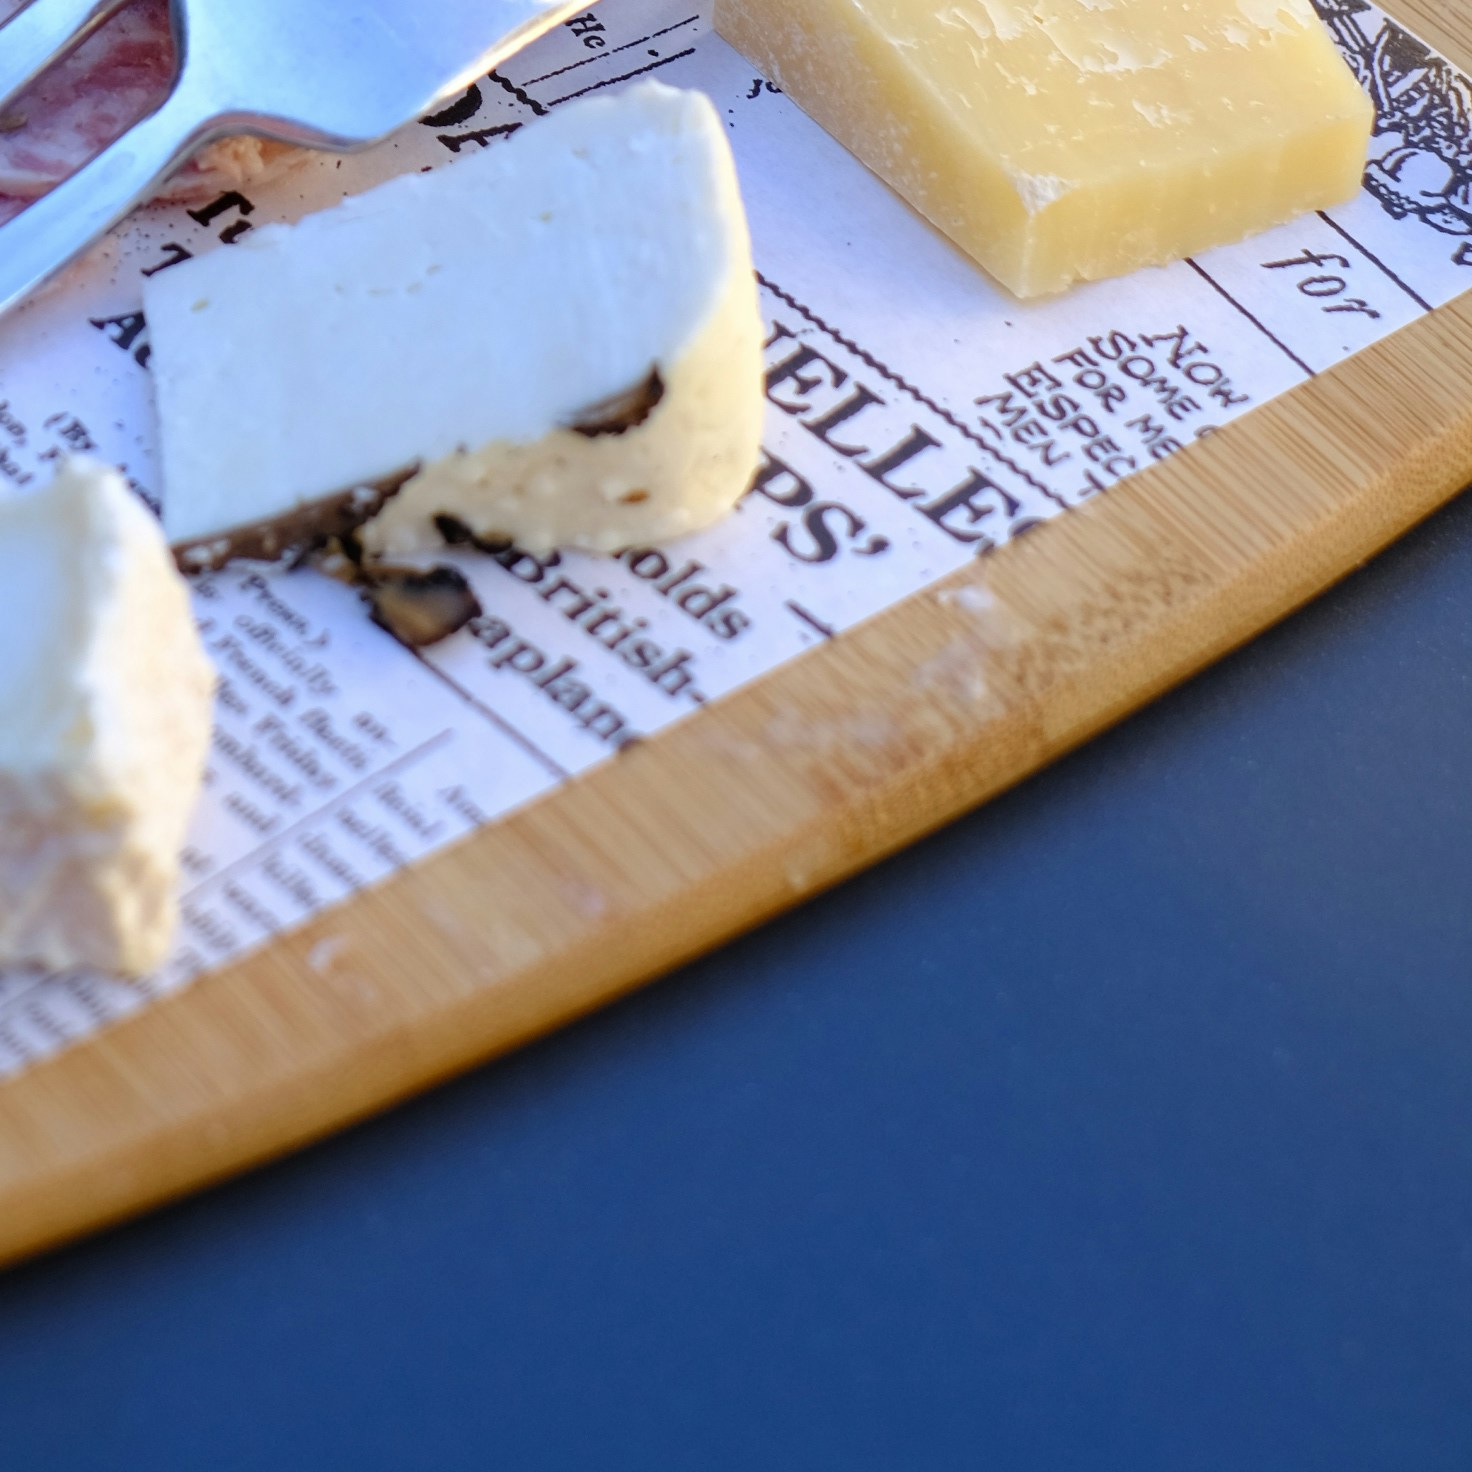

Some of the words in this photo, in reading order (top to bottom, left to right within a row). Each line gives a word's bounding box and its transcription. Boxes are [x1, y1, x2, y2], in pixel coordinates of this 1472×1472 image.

[1260, 247, 1381, 320] for
[1052, 345, 1129, 414] FOR
[1088, 329, 1201, 420] SOME
[1137, 324, 1250, 406] NOW
[976, 392, 1075, 469] MEN
